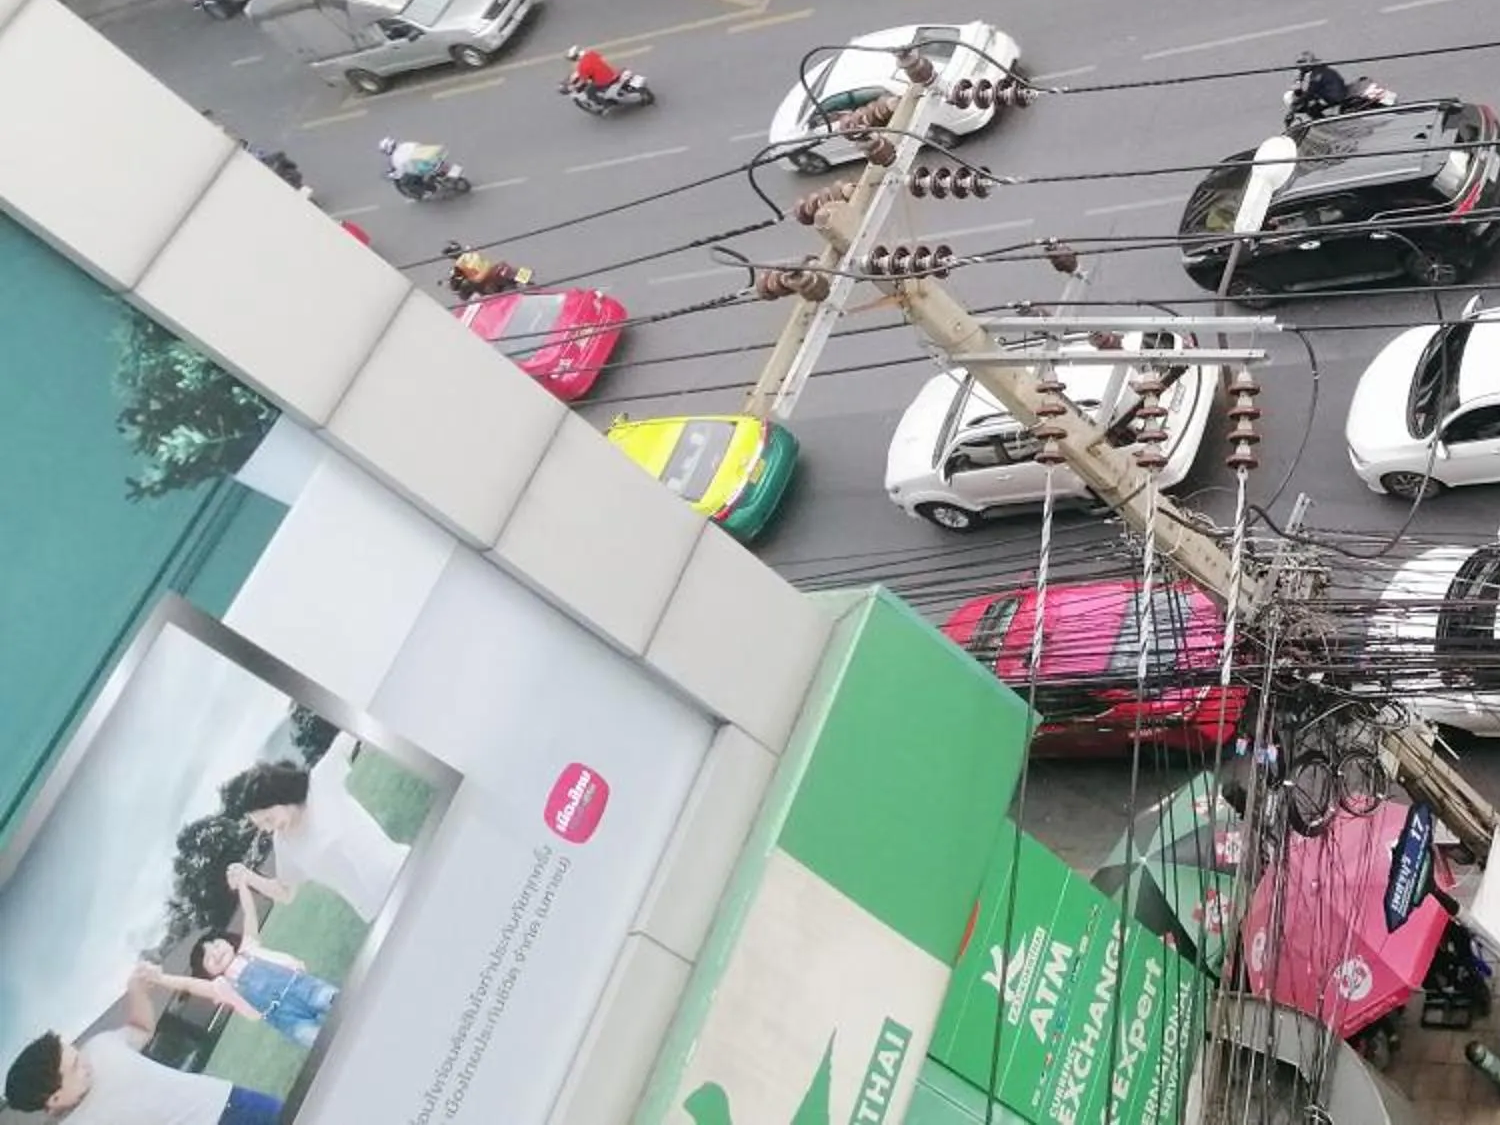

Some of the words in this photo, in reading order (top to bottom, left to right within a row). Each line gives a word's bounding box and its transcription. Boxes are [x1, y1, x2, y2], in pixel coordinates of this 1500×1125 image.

[1411, 813, 1424, 841] 17
[1029, 940, 1073, 1045] ATM
[1055, 918, 1130, 1125] EXCHANGE
[853, 1030, 905, 1125] THAI
[1141, 980, 1192, 1125] ERNATIONAL
